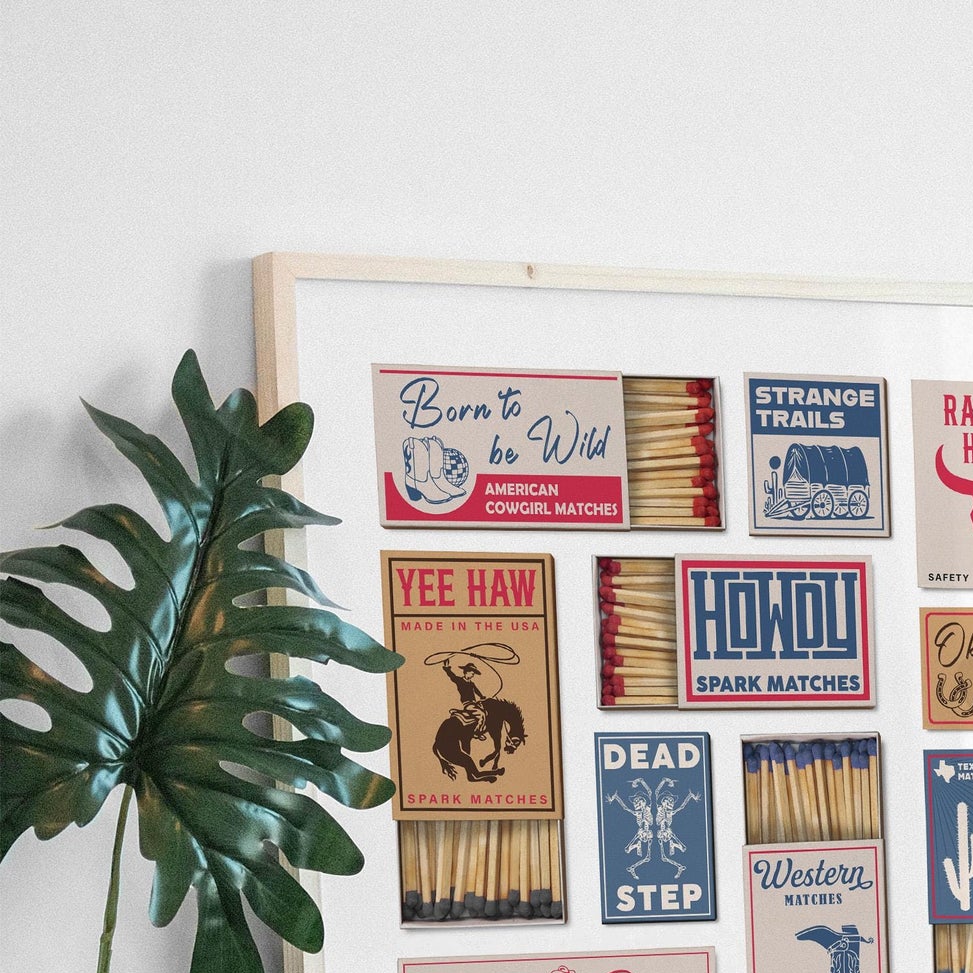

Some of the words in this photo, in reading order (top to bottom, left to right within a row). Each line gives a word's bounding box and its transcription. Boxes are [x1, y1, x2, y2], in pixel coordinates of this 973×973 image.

[400, 377, 492, 429] Born
[498, 387, 522, 418] to
[755, 386, 875, 407] STRANGE
[756, 410, 846, 429] TRAILS
[489, 434, 519, 465] be
[527, 411, 611, 465] Wild
[485, 482, 559, 496] AMERICAN
[486, 501, 551, 515] COWGIRL
[555, 502, 618, 516] MATCHES
[928, 572, 969, 582] SAFETY
[396, 568, 455, 607] YEE
[466, 569, 537, 607] HAW
[690, 571, 858, 660] HOWDY
[401, 621, 443, 631] MADE
[452, 621, 467, 631] IN
[475, 622, 503, 631] THE
[511, 622, 540, 631] USA
[696, 675, 762, 692] SPARK
[767, 675, 860, 692] MATCHES
[603, 743, 700, 770] DEAD
[407, 794, 462, 804] SPARK
[471, 794, 548, 805] MATCHES
[753, 857, 873, 891] Western
[616, 884, 702, 912] STEP
[784, 893, 842, 906] MATCHES
